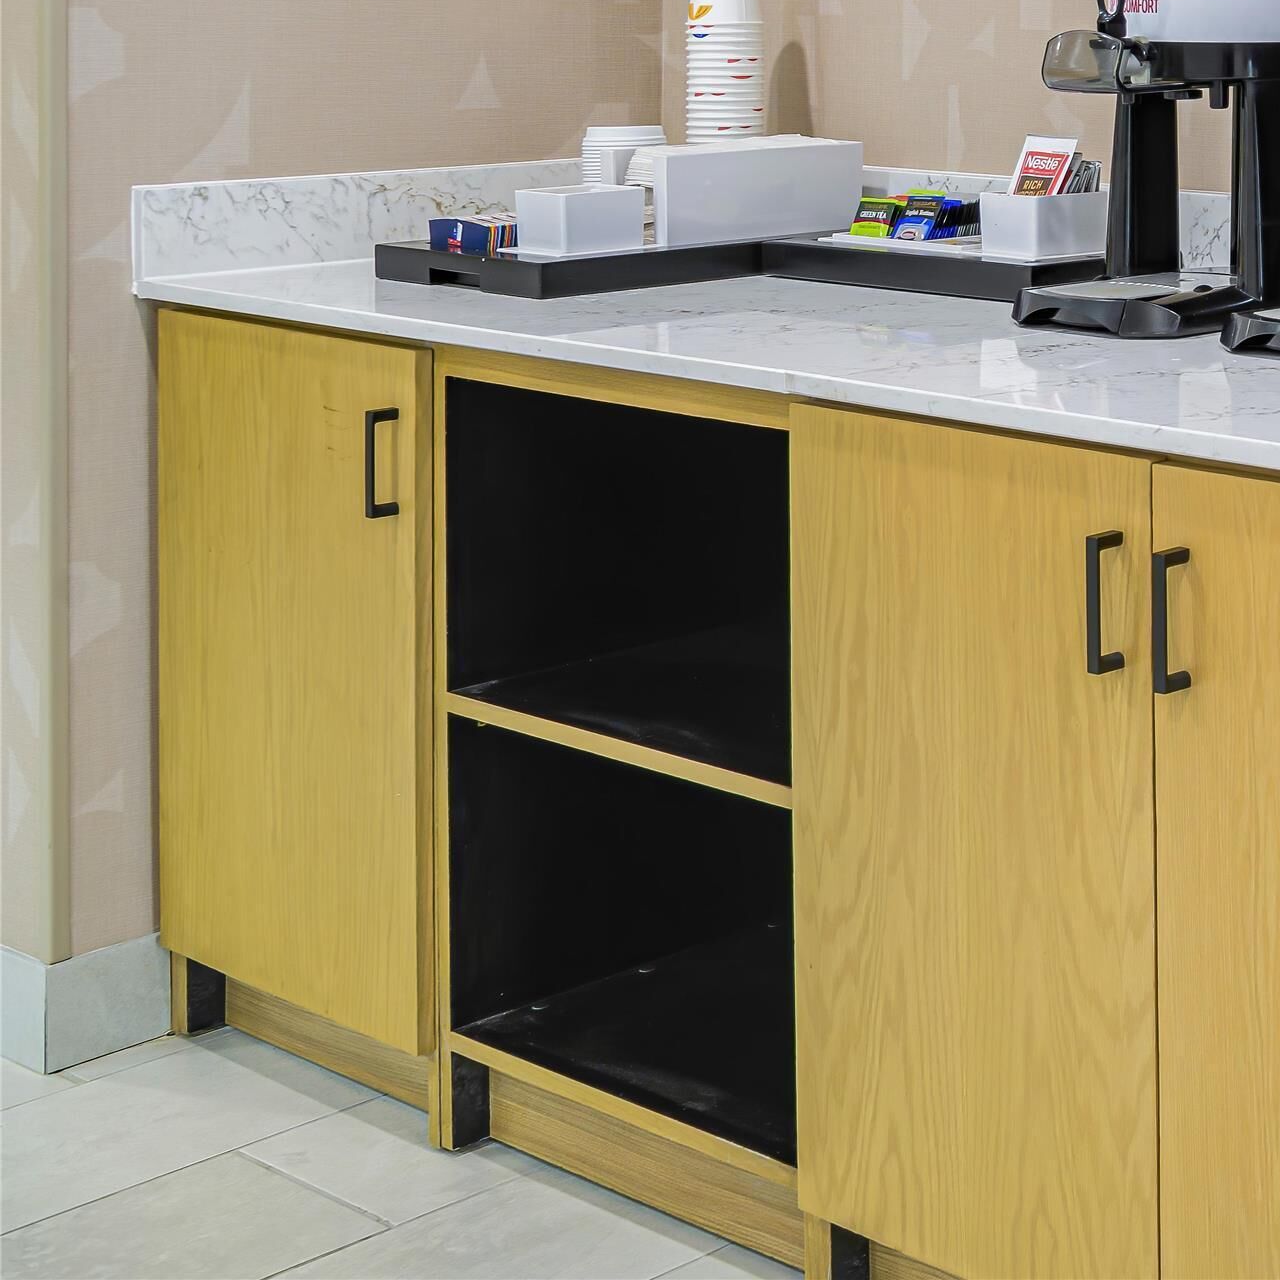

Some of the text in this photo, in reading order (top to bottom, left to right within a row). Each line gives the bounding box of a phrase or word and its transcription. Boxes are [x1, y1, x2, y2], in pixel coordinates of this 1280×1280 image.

[1023, 180, 1044, 190] RICH
[860, 210, 887, 219] GREEN TEA
